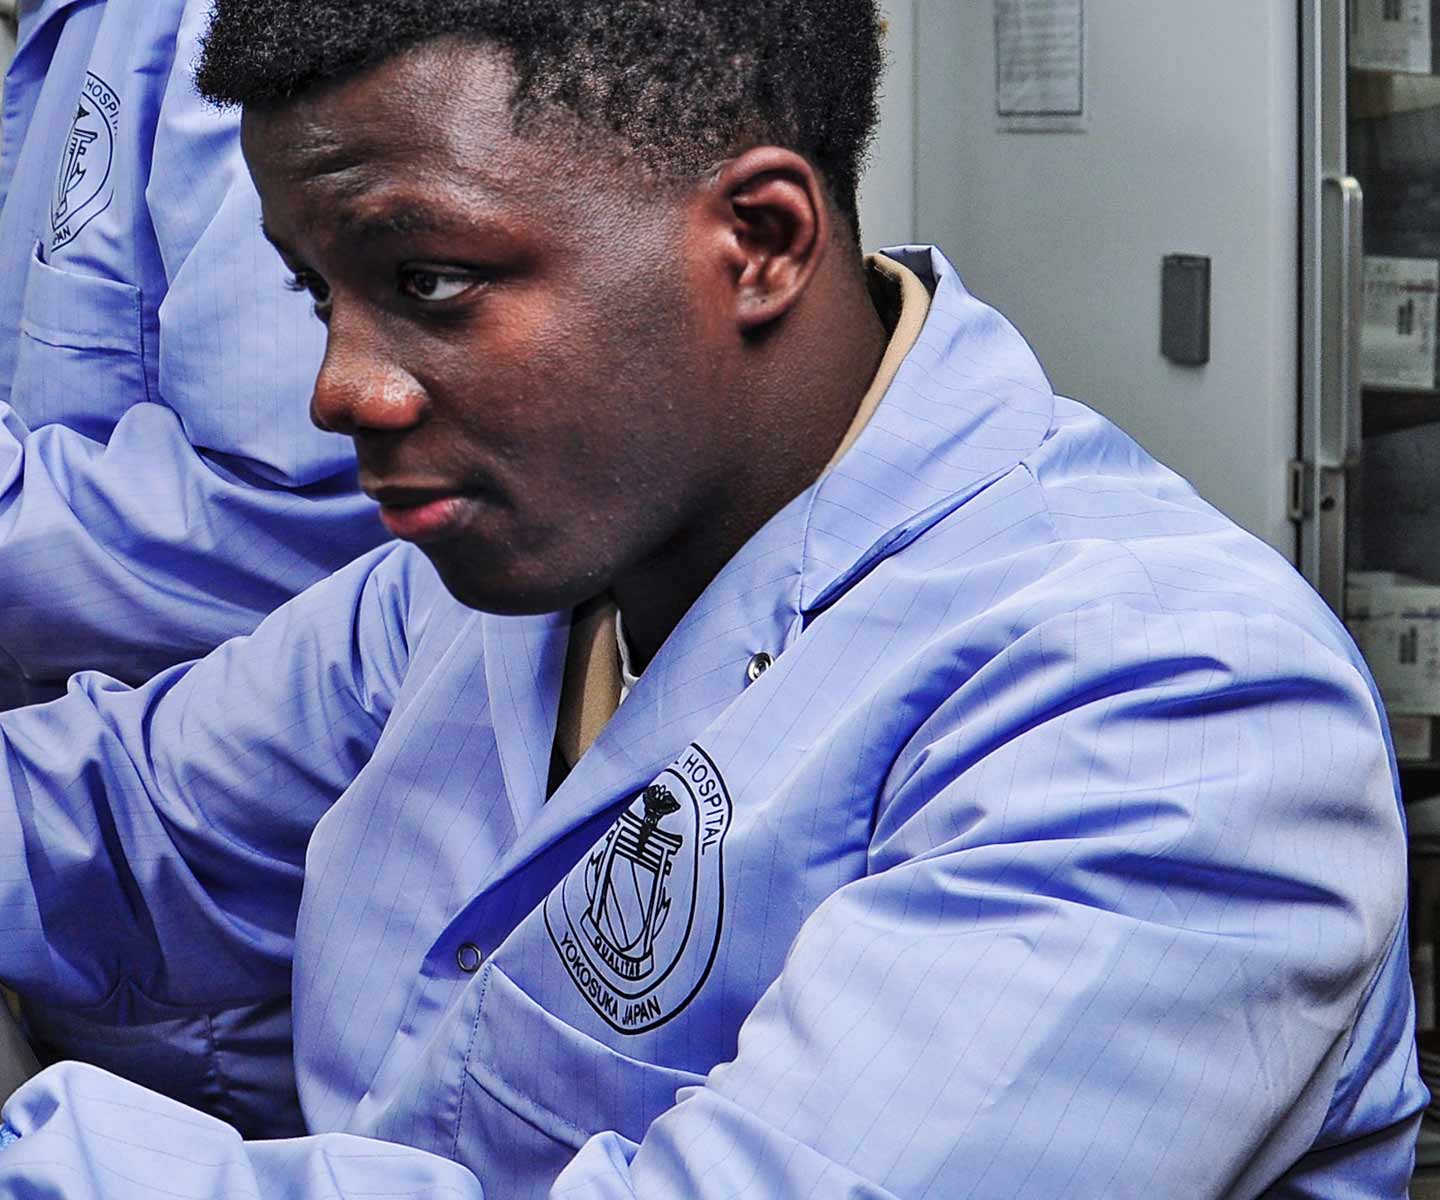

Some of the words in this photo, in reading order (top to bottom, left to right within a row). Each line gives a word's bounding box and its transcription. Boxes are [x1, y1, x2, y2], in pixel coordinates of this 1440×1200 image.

[85, 77, 119, 129] HOSPI
[682, 753, 724, 856] HOSPITAL
[561, 931, 618, 1021] YOKOSUKA
[622, 995, 662, 1026] JAPAN
